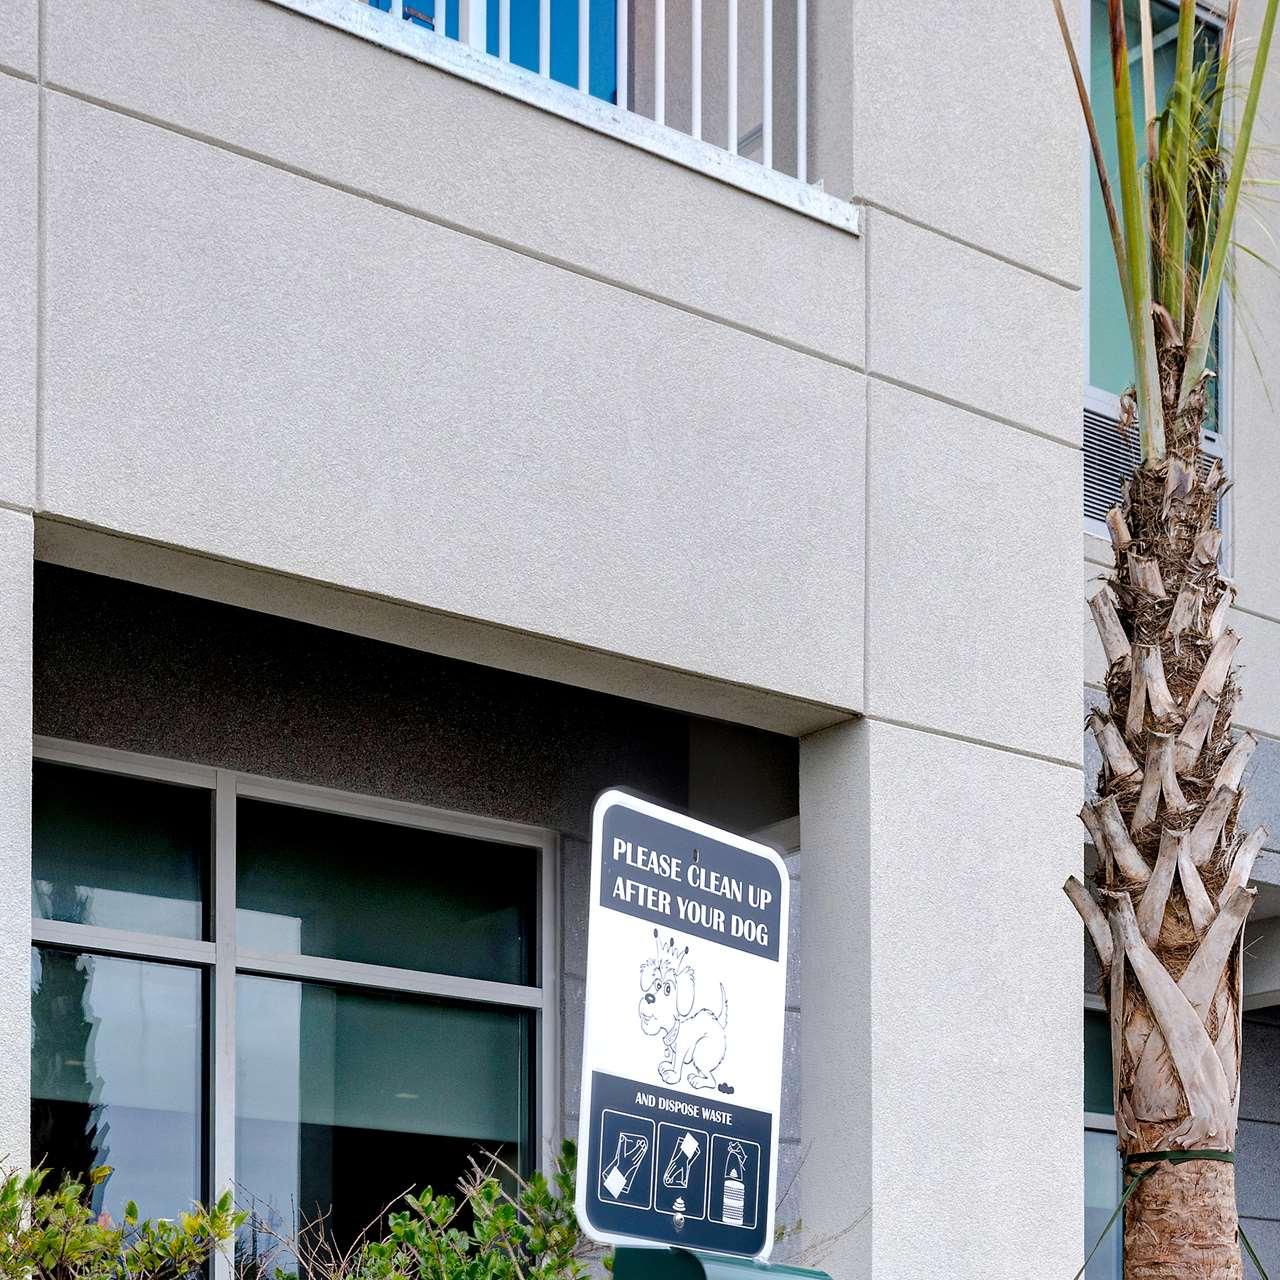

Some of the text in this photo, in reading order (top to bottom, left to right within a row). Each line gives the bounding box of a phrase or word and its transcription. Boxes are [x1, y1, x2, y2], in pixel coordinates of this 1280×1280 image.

[612, 837, 772, 910] PLEASE CLEAN UP
[612, 876, 768, 946] AFTER YOUR DOG
[635, 1091, 732, 1125] AND DISPOSE WASTE
